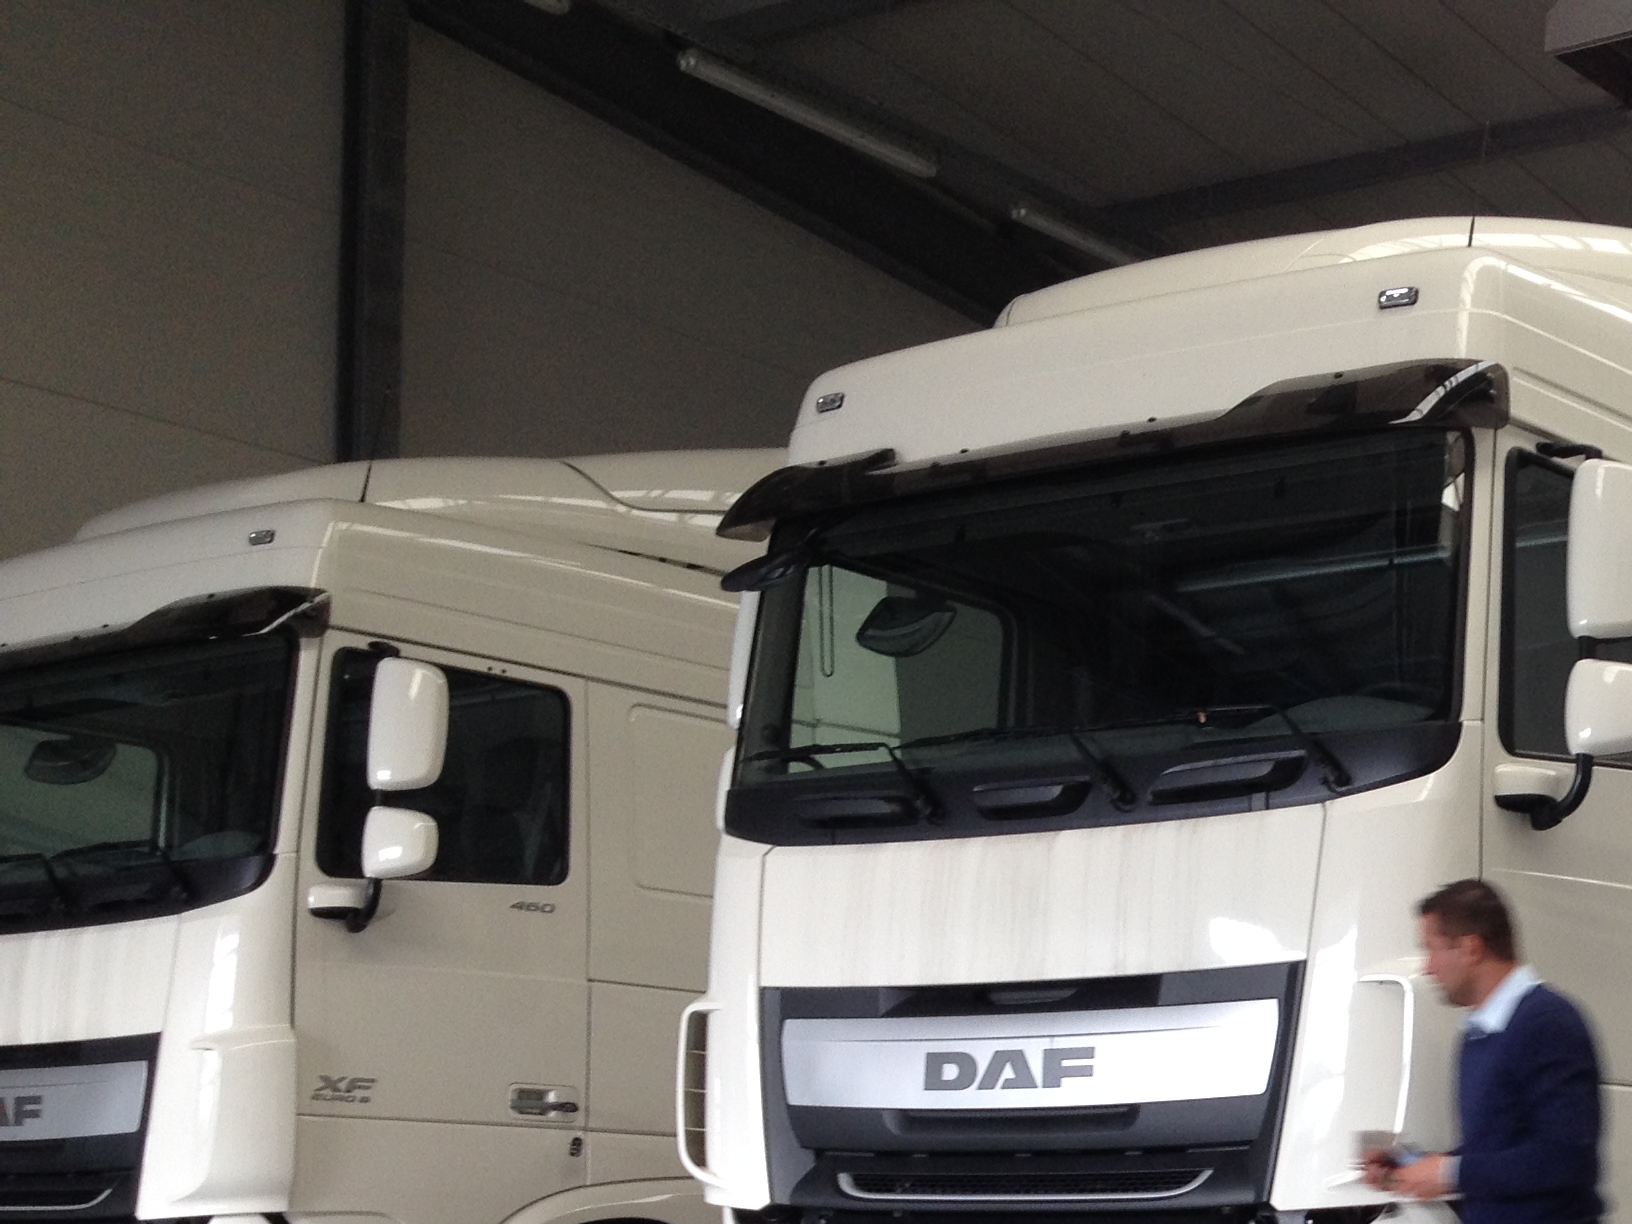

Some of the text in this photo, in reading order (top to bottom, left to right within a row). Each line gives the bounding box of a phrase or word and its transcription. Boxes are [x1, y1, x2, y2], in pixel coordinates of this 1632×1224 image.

[509, 901, 556, 913] 460
[924, 1046, 1095, 1091] DAF
[314, 1074, 377, 1093] XF
[0, 1095, 43, 1127] F
